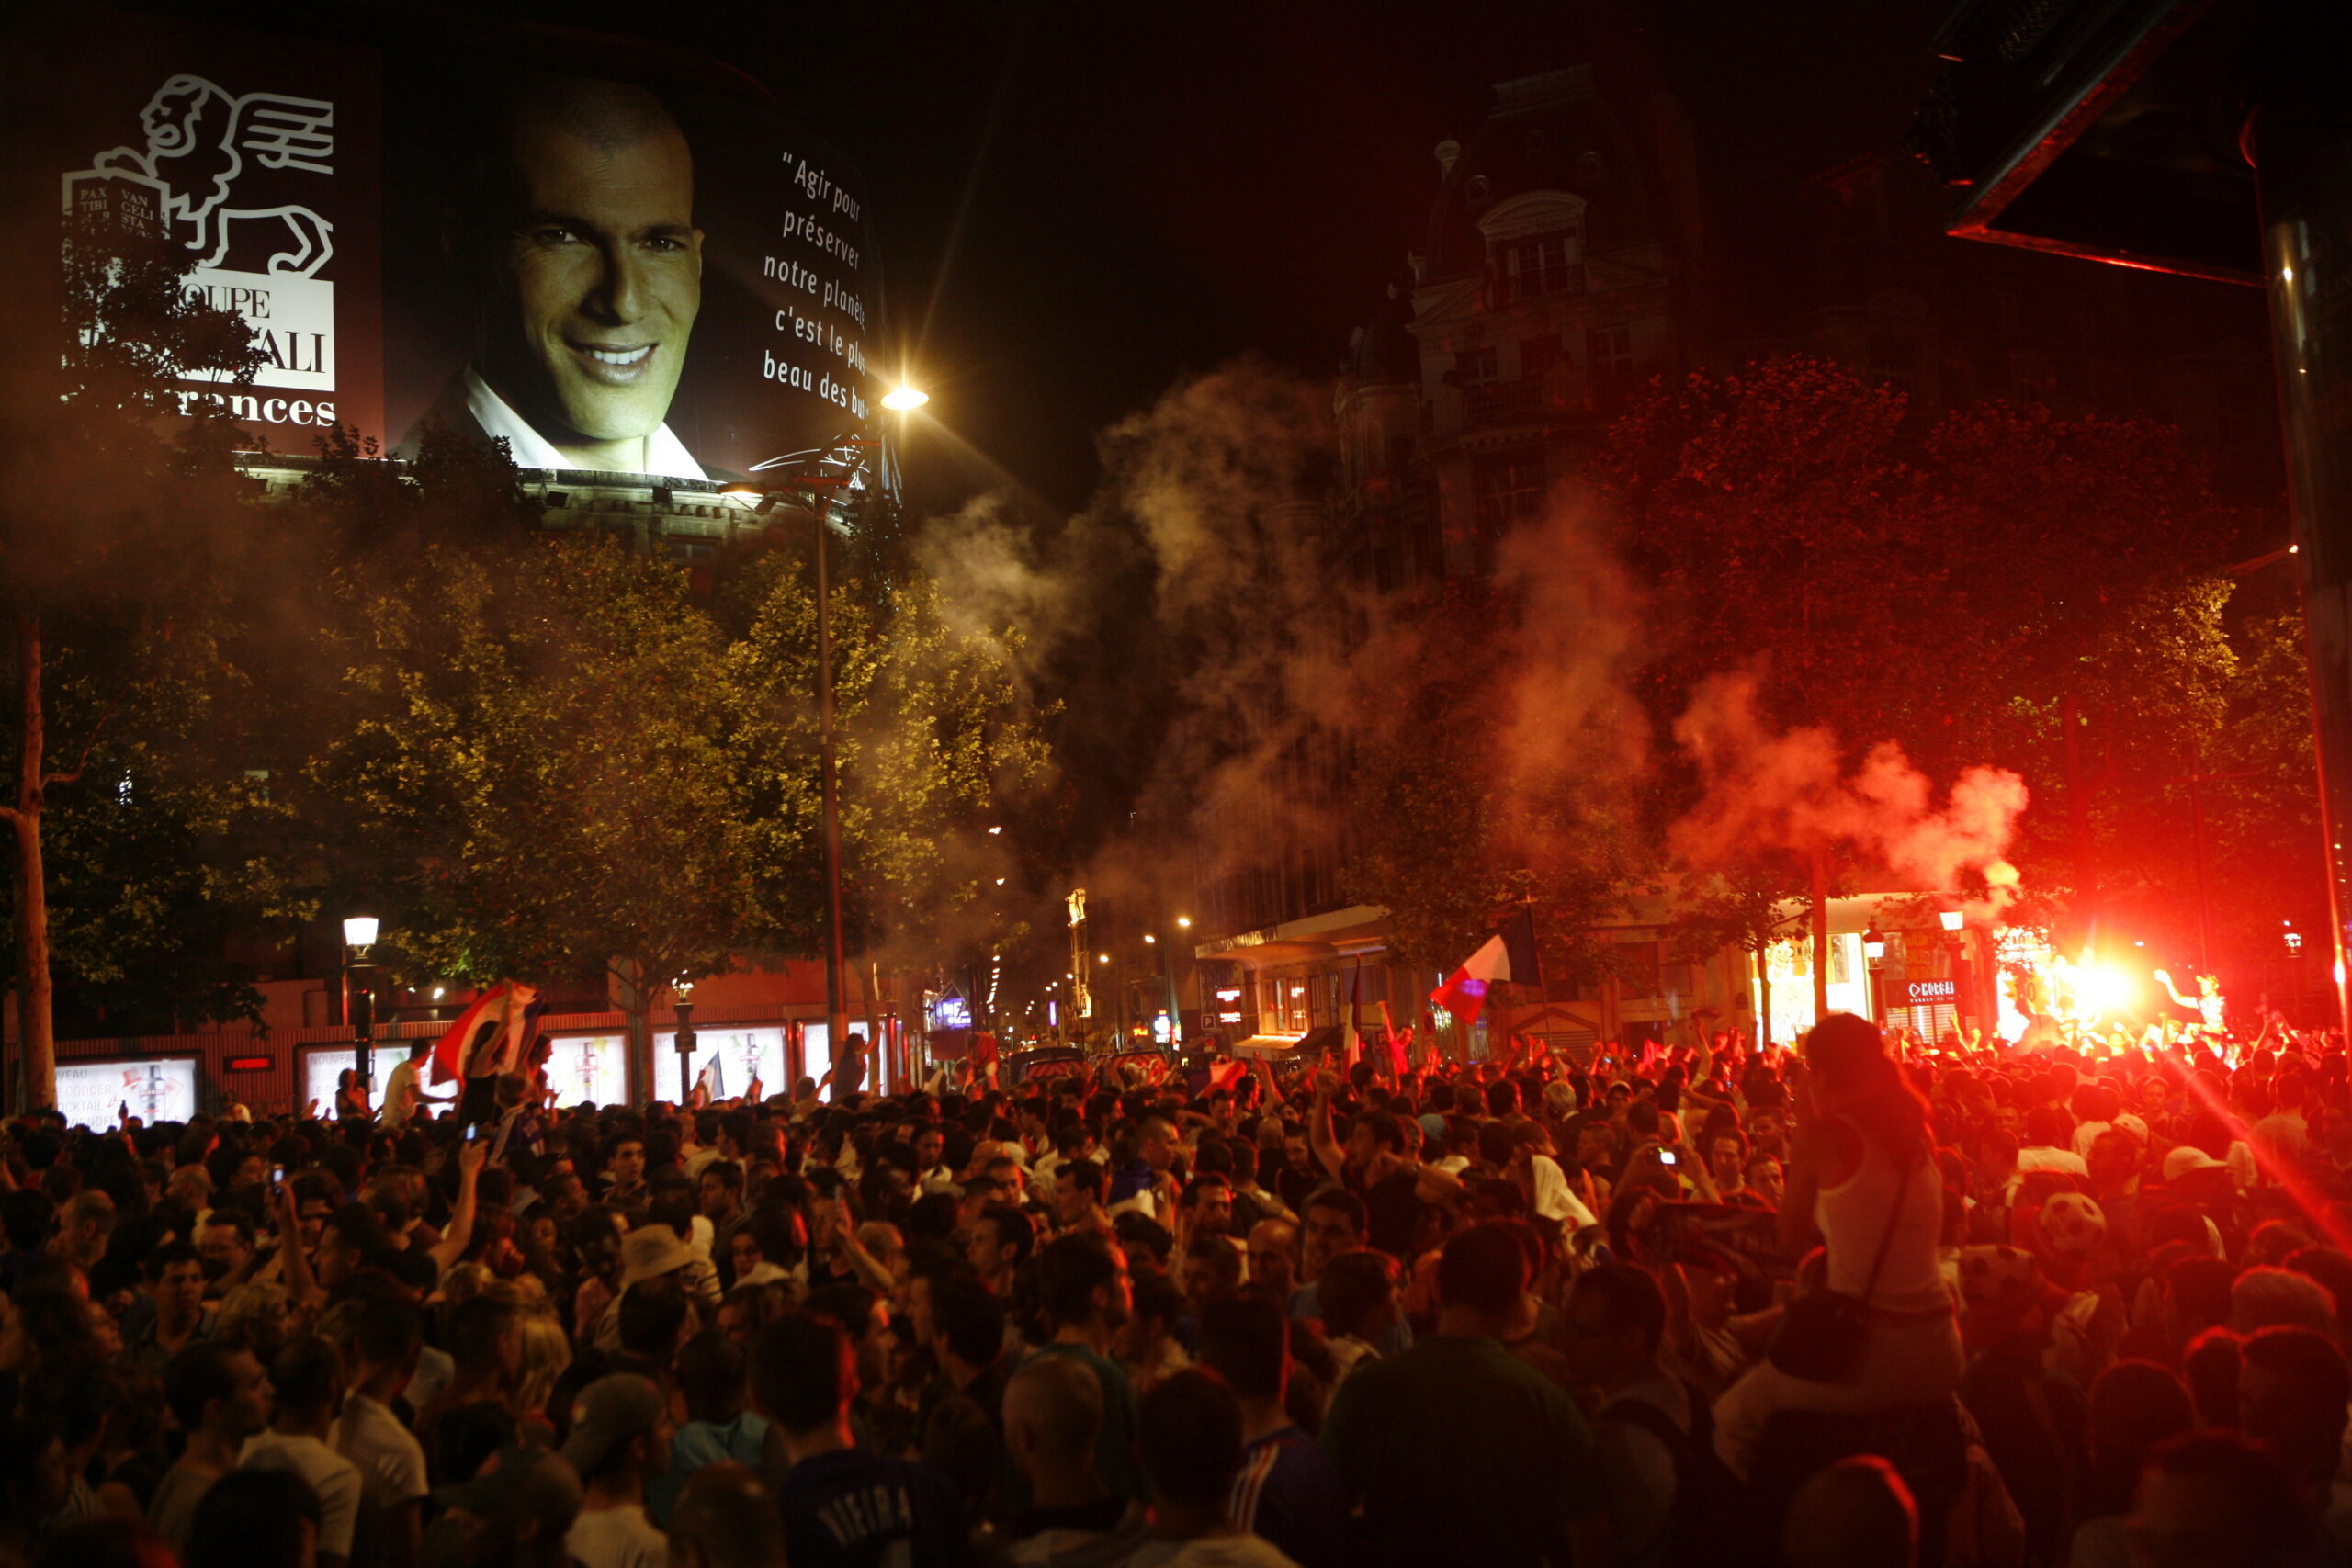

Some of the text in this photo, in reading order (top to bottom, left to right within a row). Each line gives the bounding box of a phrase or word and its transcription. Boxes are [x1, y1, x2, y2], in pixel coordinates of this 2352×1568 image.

[79, 186, 108, 200] PAX
[79, 199, 108, 212] TIBI
[120, 188, 148, 208] VAN
[832, 186, 861, 223] pour
[782, 210, 860, 270] préserver
[763, 255, 818, 294] notre
[176, 282, 271, 319] OUPE
[775, 306, 823, 346] c'est
[829, 323, 843, 356] le
[763, 349, 813, 392] beau
[820, 371, 847, 408] des
[309, 1054, 356, 1066] NOUVEA
[57, 1068, 88, 1081] VEAU
[57, 1101, 103, 1114] OCKTAIL
